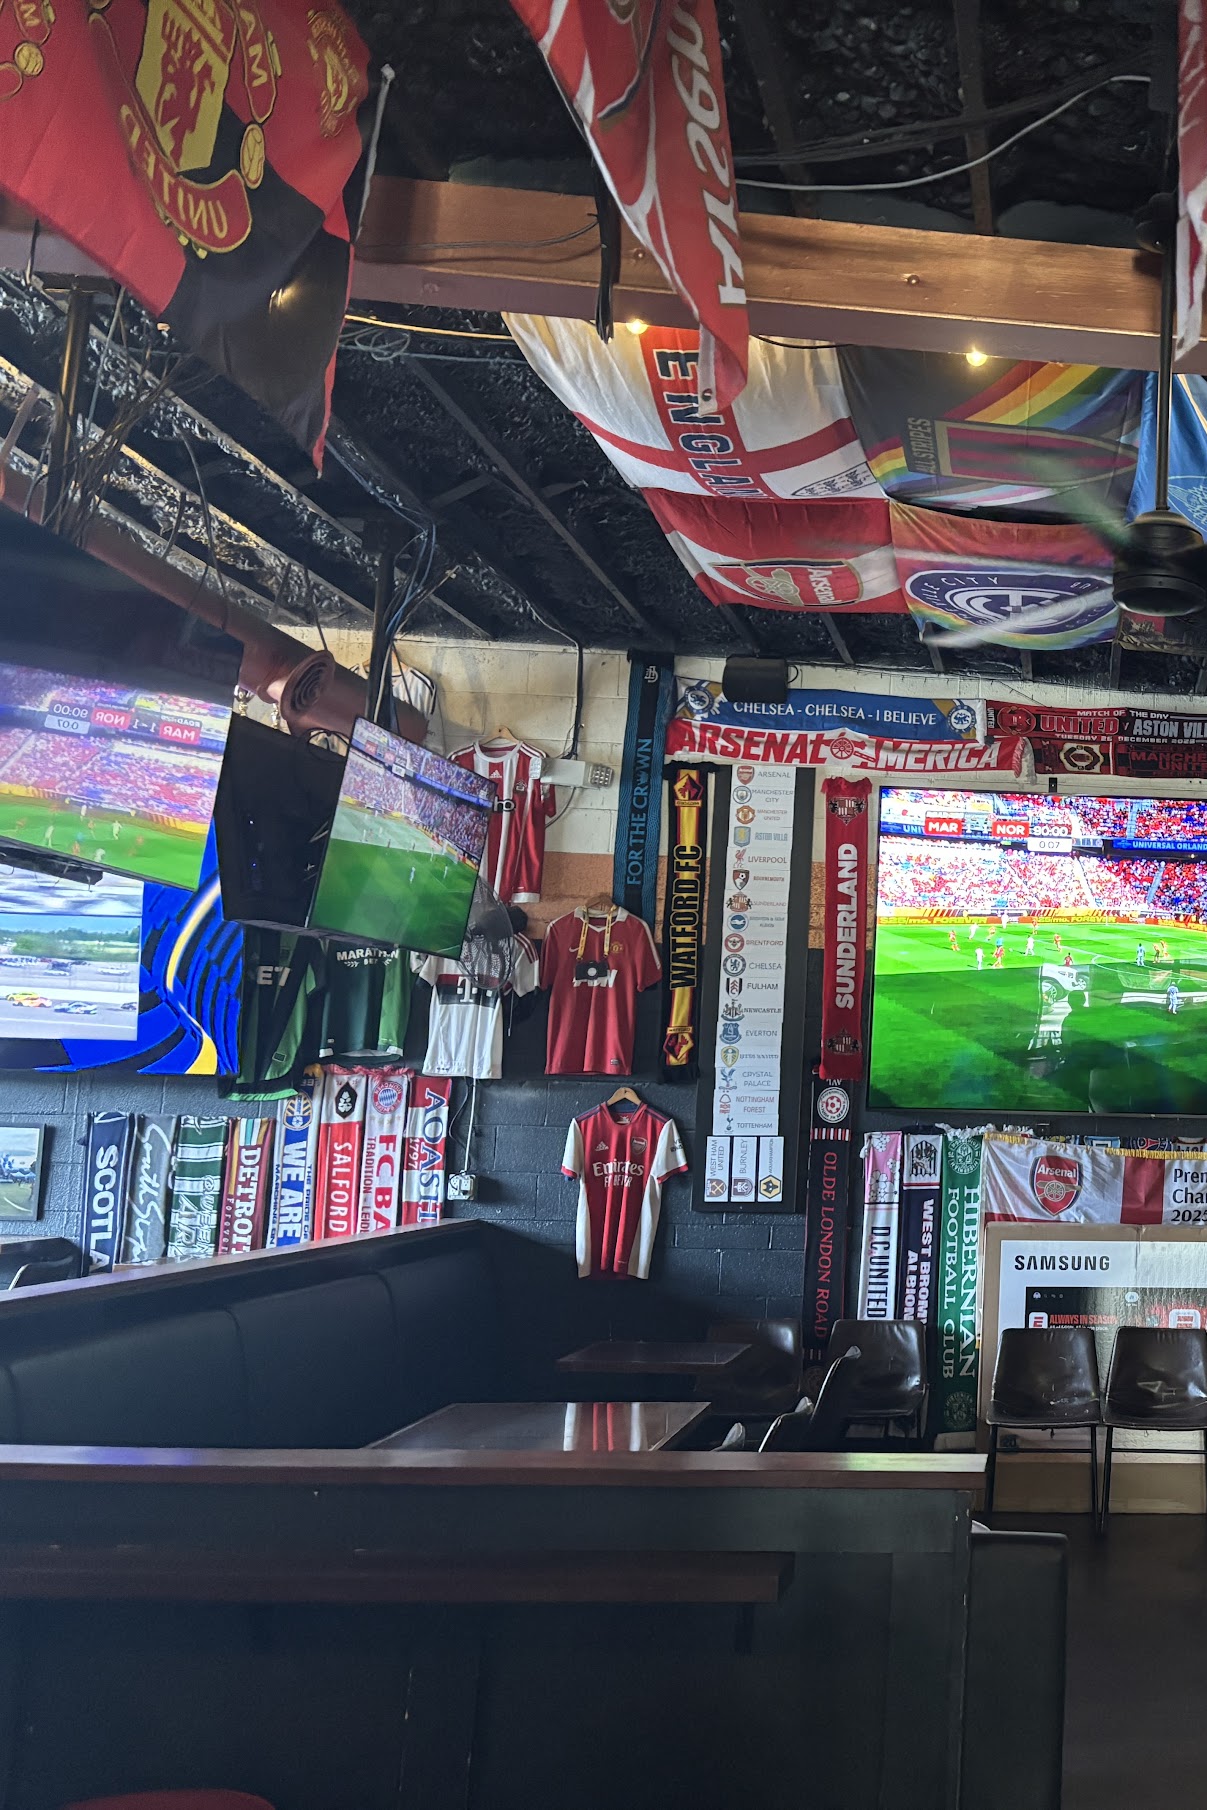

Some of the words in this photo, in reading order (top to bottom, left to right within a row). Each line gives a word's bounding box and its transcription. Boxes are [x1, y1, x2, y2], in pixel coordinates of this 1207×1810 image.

[940, 576, 999, 586] CITY
[734, 701, 794, 716] CHELSEA
[805, 705, 865, 720] CHELSEA
[884, 710, 936, 726] BELIEVE
[1040, 715, 1119, 735] UNITED
[1133, 719, 1178, 737] ASTON
[666, 718, 827, 765] ARSENAL
[852, 735, 1002, 771] AMERICA
[1055, 733, 1098, 741] TUESDAY
[629, 813, 646, 848] THE
[928, 820, 958, 834] MAR
[996, 824, 1025, 837] NOR
[1132, 840, 1175, 851] UNIVERSAL
[627, 849, 643, 886] FOR
[673, 843, 702, 876] FC
[748, 856, 788, 864] LIVERPOOL
[670, 881, 701, 989] WATFORD
[836, 843, 858, 1010] SUNDERLAND
[934, 915, 988, 924] FOREVER
[746, 939, 784, 947] BRENTFORD
[736, 1095, 775, 1103] NOTTINGHAM
[282, 1141, 307, 1181] WE
[364, 1135, 377, 1195] TRADITION
[375, 1134, 397, 1177] FC
[407, 1137, 418, 1170] 1797
[592, 1160, 645, 1178] Emirates
[717, 1145, 725, 1171] UNITED
[739, 1139, 747, 1174] BURNLEY
[1037, 1164, 1077, 1179] Arsenal
[271, 1163, 281, 1225] MARCHING
[328, 1141, 353, 1233] SALFORD
[823, 1151, 838, 1209] OLDE
[89, 1144, 119, 1271] SCOTLA
[278, 1185, 304, 1240] ARE
[371, 1186, 393, 1229] BA
[919, 1198, 935, 1250] WEST
[818, 1210, 835, 1285] LONDON
[943, 1187, 961, 1310] FOOTBALL
[1014, 1254, 1111, 1272] SAMSUNG
[866, 1254, 891, 1319] UNITED
[903, 1250, 919, 1321] ALBION
[960, 1185, 981, 1378] HIBERNIAN
[814, 1287, 831, 1340] ROAD
[1050, 1314, 1079, 1325] ALWAYS
[1080, 1314, 1089, 1325] IN
[942, 1318, 956, 1379] CLUB
